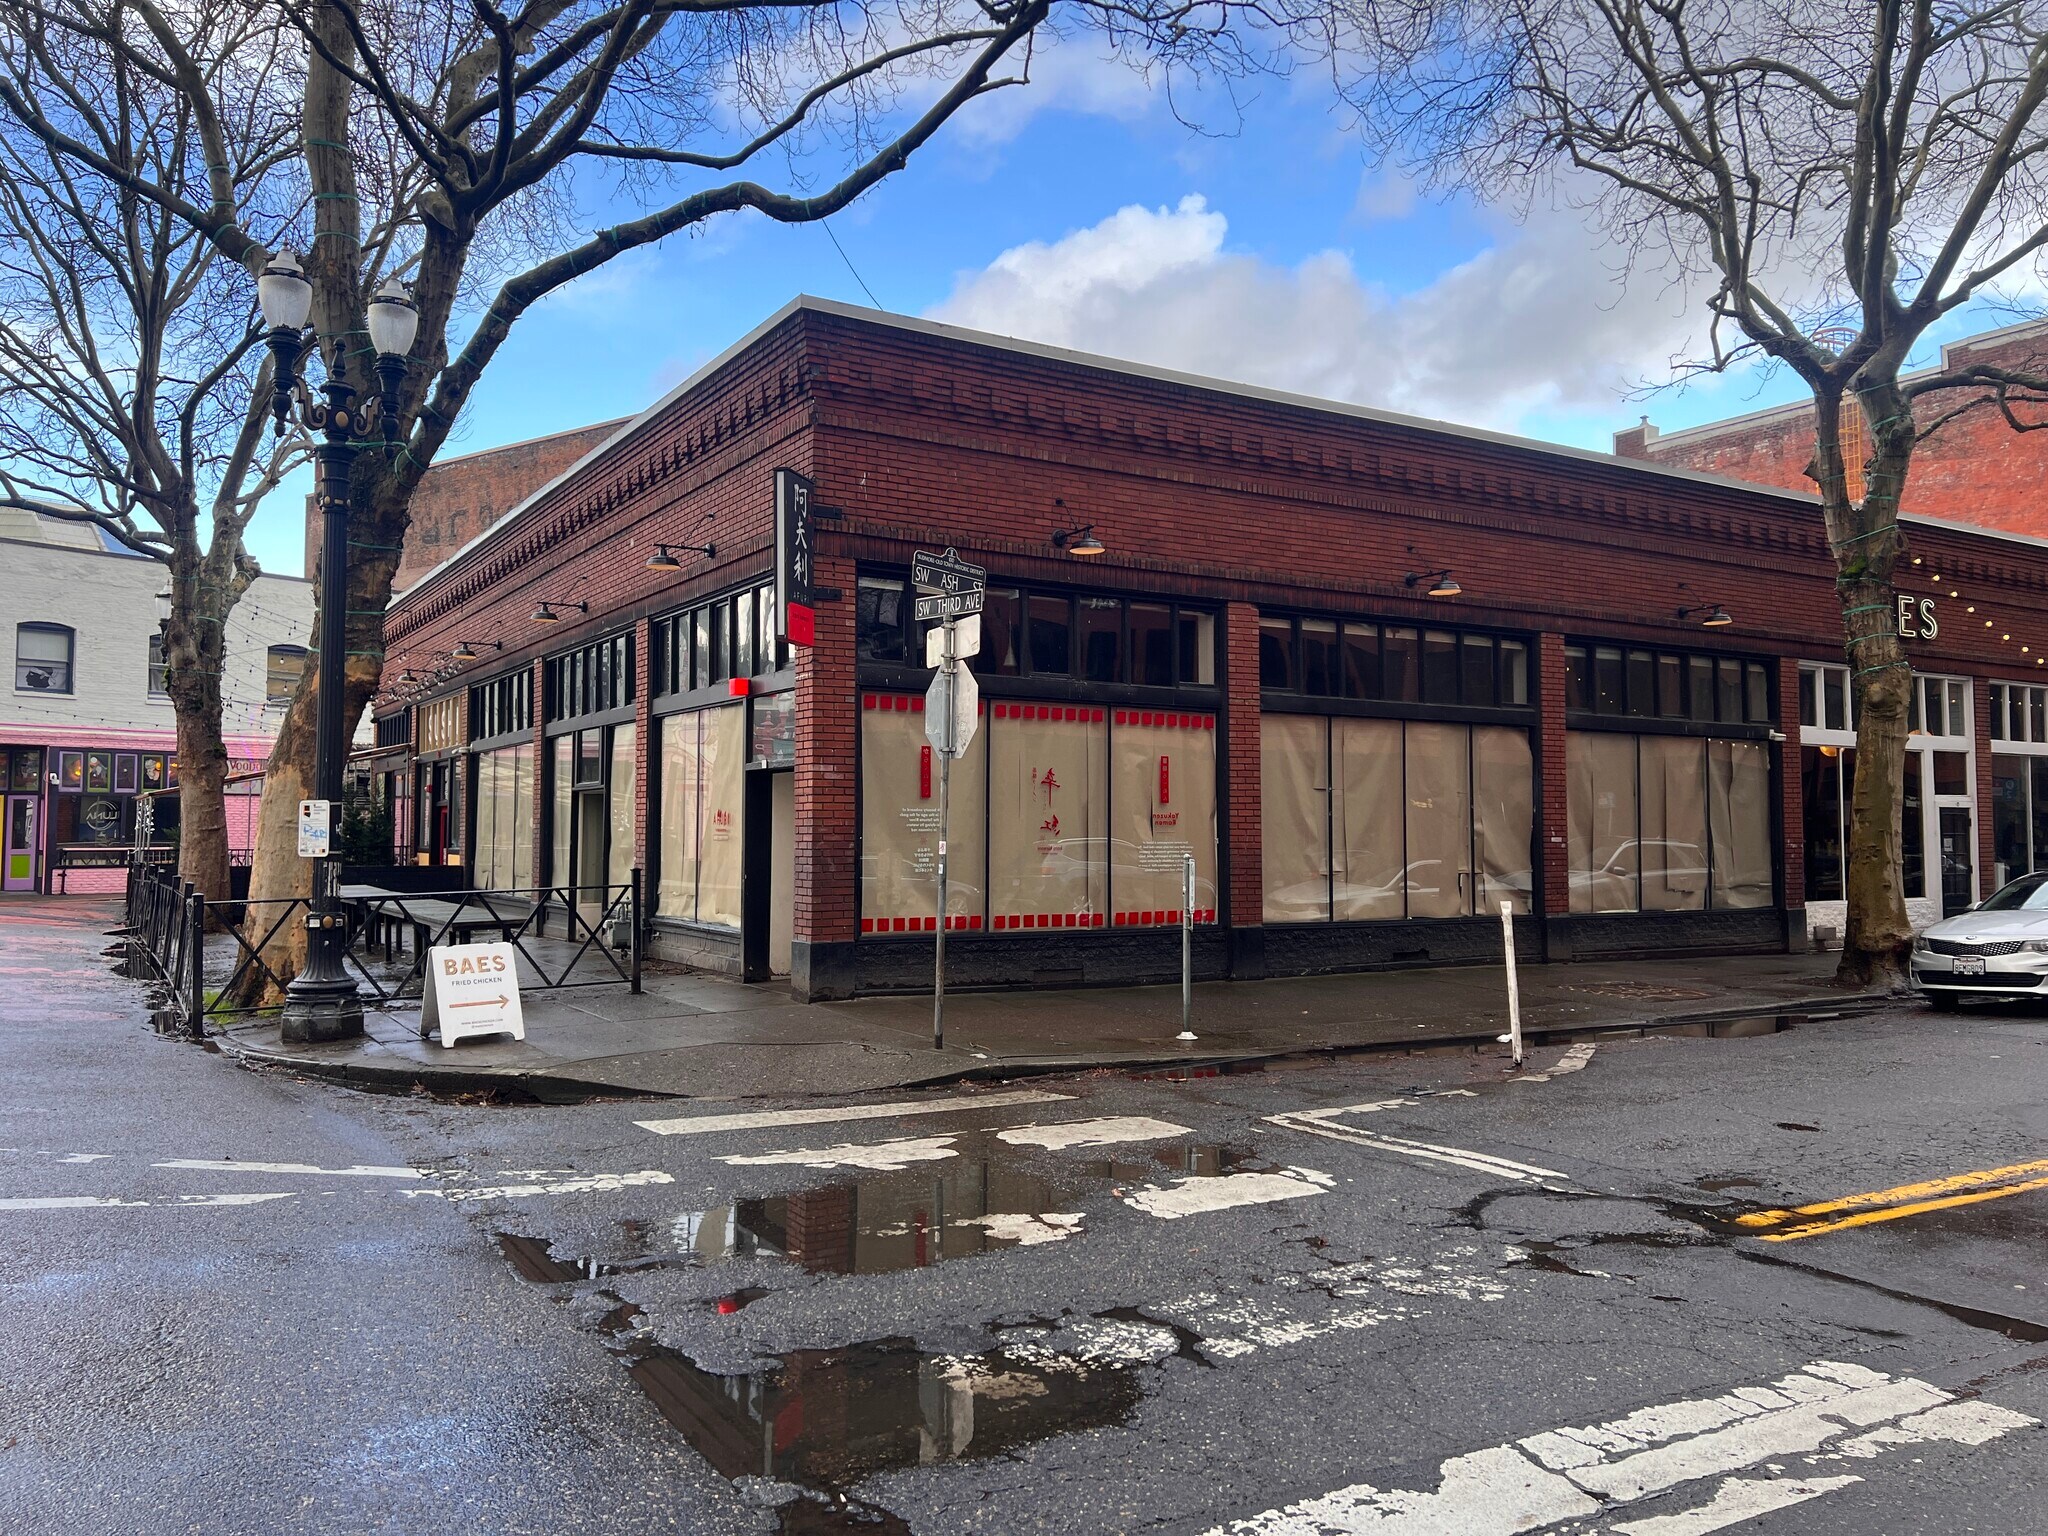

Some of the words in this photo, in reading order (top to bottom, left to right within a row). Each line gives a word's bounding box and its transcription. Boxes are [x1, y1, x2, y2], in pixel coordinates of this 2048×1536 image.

[793, 483, 808, 588] 阿夫利
[915, 566, 930, 583] SW
[941, 573, 959, 590] ASH
[918, 601, 931, 616] SW
[937, 596, 961, 613] THIRD
[965, 593, 980, 610] AVE
[1898, 595, 1938, 639] ES
[444, 955, 506, 976] BAES
[451, 979, 472, 987] FRIED
[473, 977, 503, 985] CHICKEN
